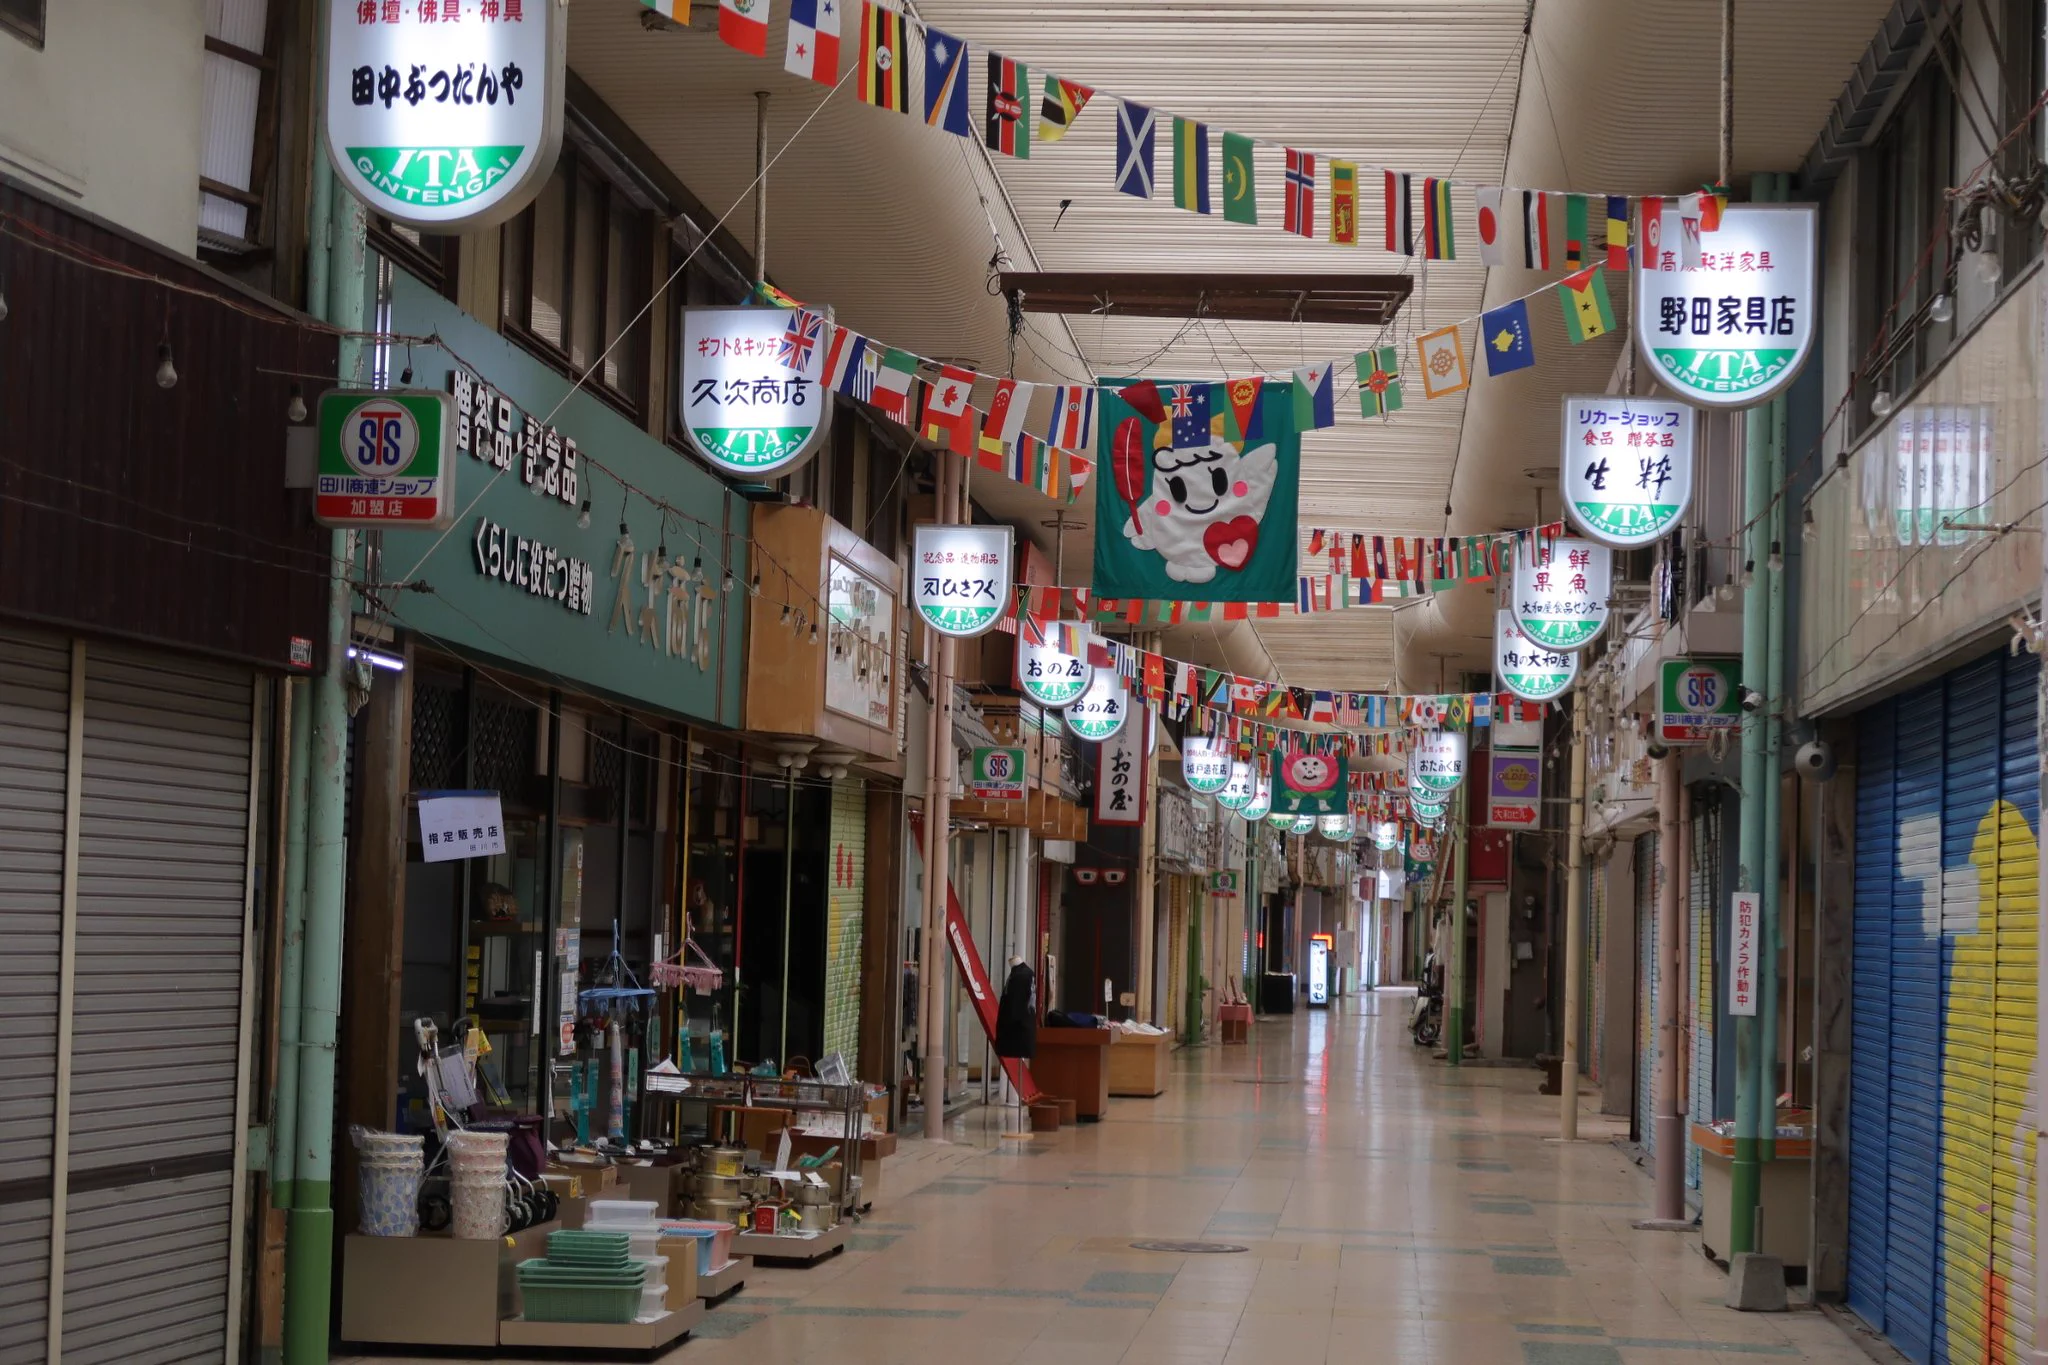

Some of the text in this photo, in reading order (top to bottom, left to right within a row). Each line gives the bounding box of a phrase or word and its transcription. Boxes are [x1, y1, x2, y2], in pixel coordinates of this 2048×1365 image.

[352, 62, 523, 110] 田中ぶつだんや
[357, 155, 512, 203] GINTENGAI
[390, 149, 482, 187] ITA
[1660, 296, 1796, 336] 野田家具店
[1661, 353, 1788, 391] GINTENGAI
[1687, 351, 1763, 380] ITA
[691, 375, 813, 407] 久次商店
[1580, 409, 1680, 427] リカーショップ
[701, 433, 802, 463] GINTENGAI
[723, 430, 782, 453] ITA
[1582, 429, 1675, 448] 食品 贈答品
[320, 477, 437, 495] 田川商連ショップ
[351, 499, 403, 516] 加盟店
[1600, 504, 1655, 527] ITA
[1580, 506, 1672, 535] GINTENGAI
[474, 516, 593, 616] くらしに役だつ贈物
[939, 607, 979, 624] ITA
[1522, 600, 1603, 615] 大和屋食品センター
[1541, 621, 1582, 637] ITA
[1028, 658, 1084, 677] おの屋
[1504, 650, 1571, 668] 肉の大和屋
[1071, 698, 1120, 714] おの屋
[1420, 760, 1462, 773] おたふく屋
[1109, 747, 1133, 811] おの屋
[428, 826, 498, 845] 指定販売店
[1737, 901, 1752, 1007] 防犯カメラ作動中
